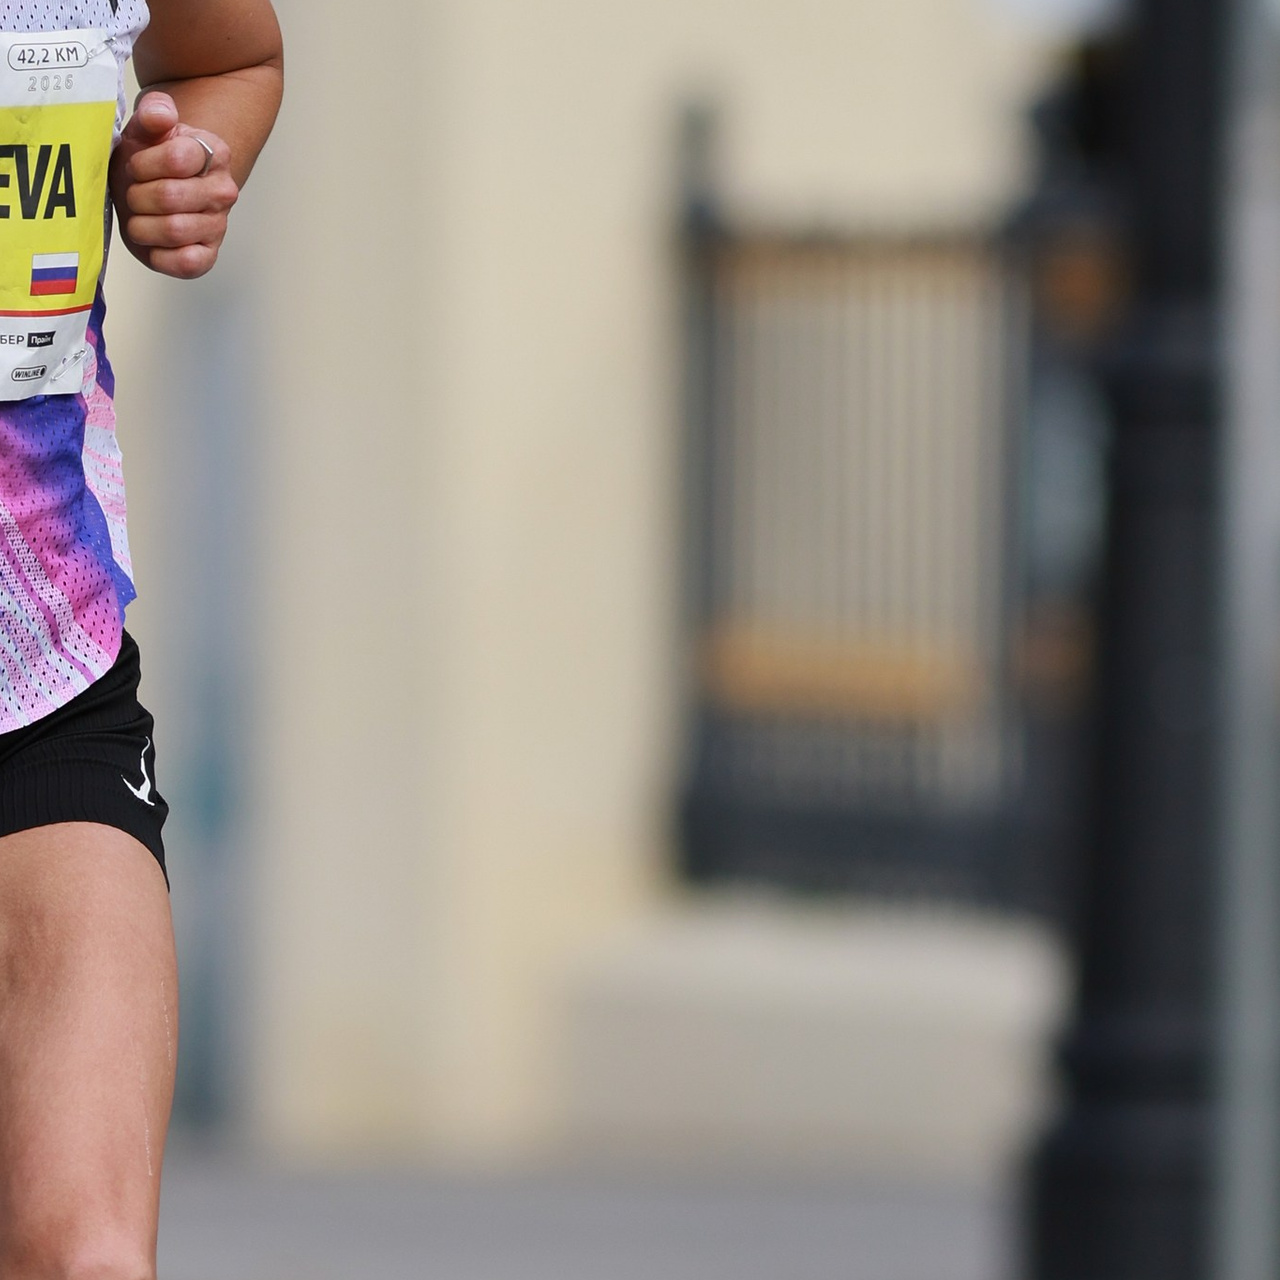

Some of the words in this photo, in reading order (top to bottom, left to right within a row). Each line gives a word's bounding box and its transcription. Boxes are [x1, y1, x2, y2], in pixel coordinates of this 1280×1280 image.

[17, 48, 50, 66] 42,2
[27, 74, 74, 92] 2026
[14, 368, 41, 379] WINLINE
